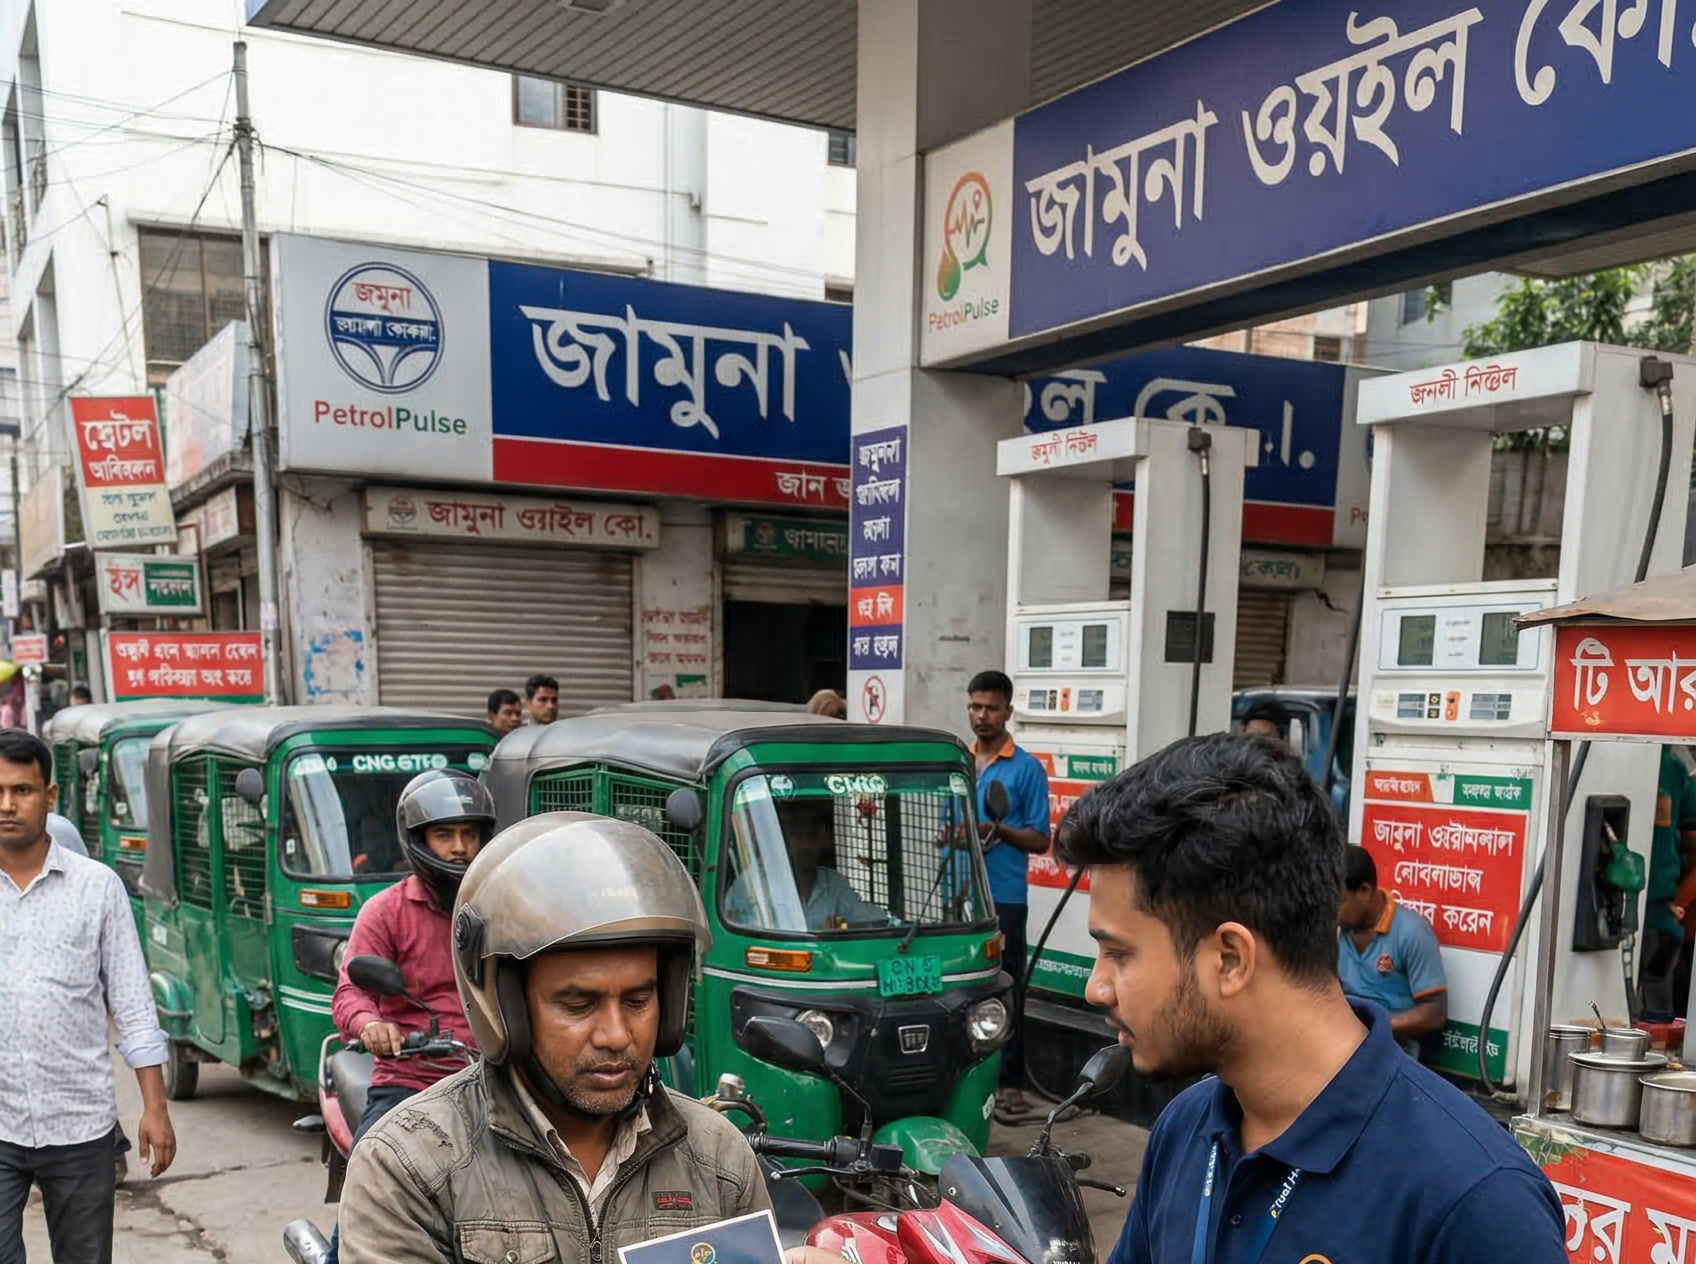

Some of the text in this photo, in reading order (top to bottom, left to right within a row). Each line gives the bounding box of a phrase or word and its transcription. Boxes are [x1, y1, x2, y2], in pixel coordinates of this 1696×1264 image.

[1024, 99, 1218, 271] জামুনা
[928, 296, 1000, 332] PetrolPulse
[518, 303, 811, 440] জামুনা
[314, 399, 468, 435] PetrolPulse
[425, 500, 506, 535] জামুনা
[352, 754, 396, 771] CNG
